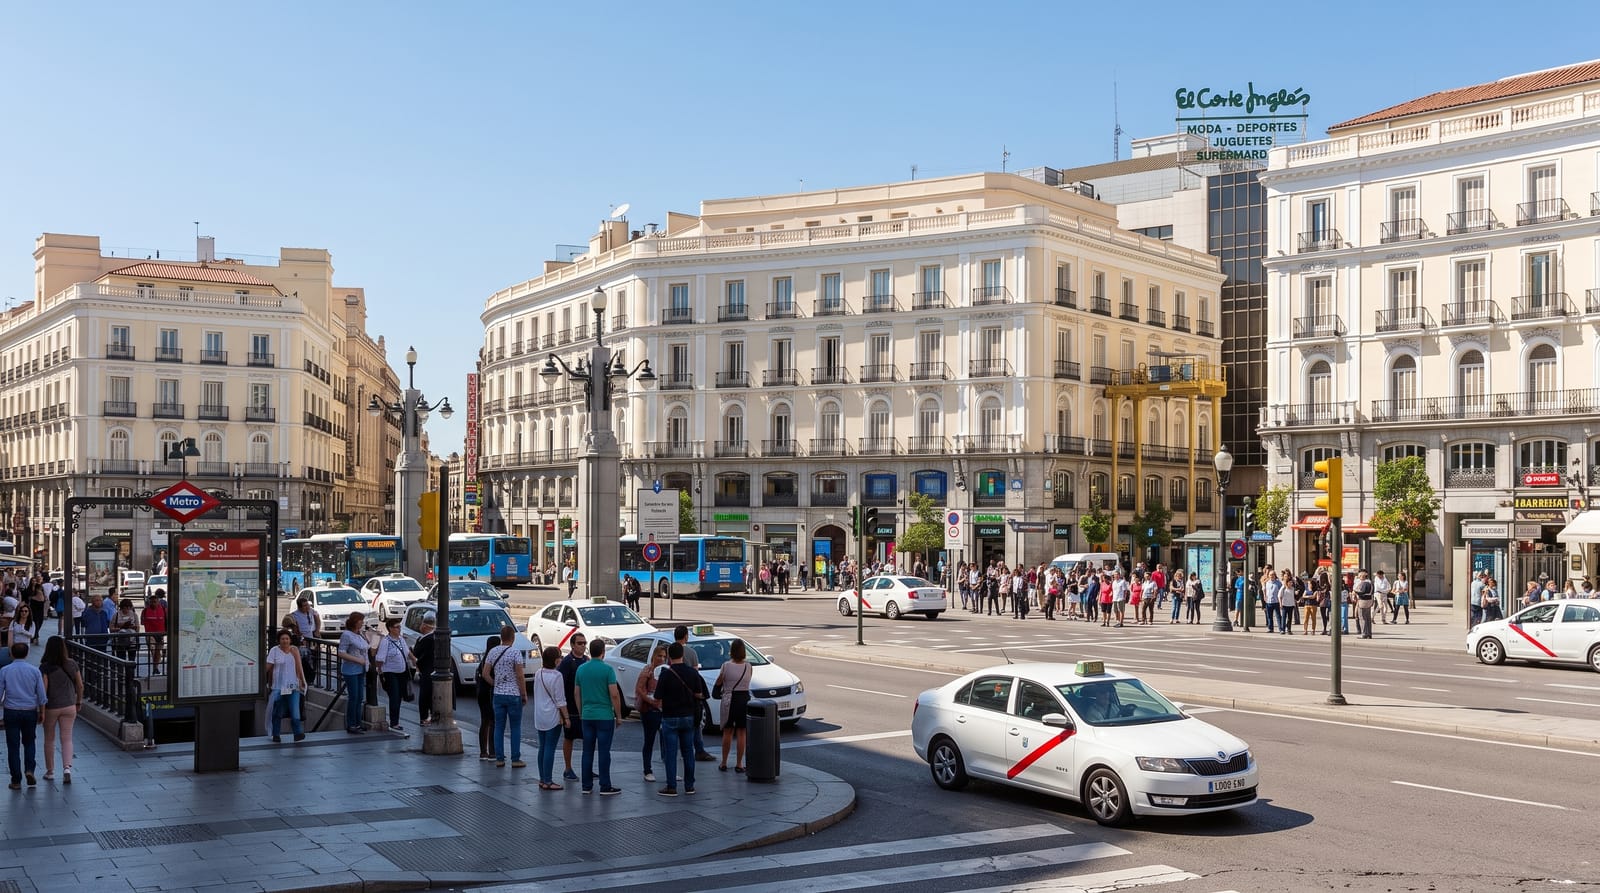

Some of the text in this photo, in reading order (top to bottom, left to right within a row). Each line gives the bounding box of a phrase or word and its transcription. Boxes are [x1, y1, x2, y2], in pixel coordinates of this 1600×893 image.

[1175, 87, 1195, 109] El
[1197, 87, 1244, 109] Corte
[1187, 124, 1222, 135] MODA
[1236, 122, 1297, 133] DEPORTES
[1213, 136, 1273, 147] JUGUETES
[169, 497, 200, 506] Metro
[208, 541, 227, 552] Sol
